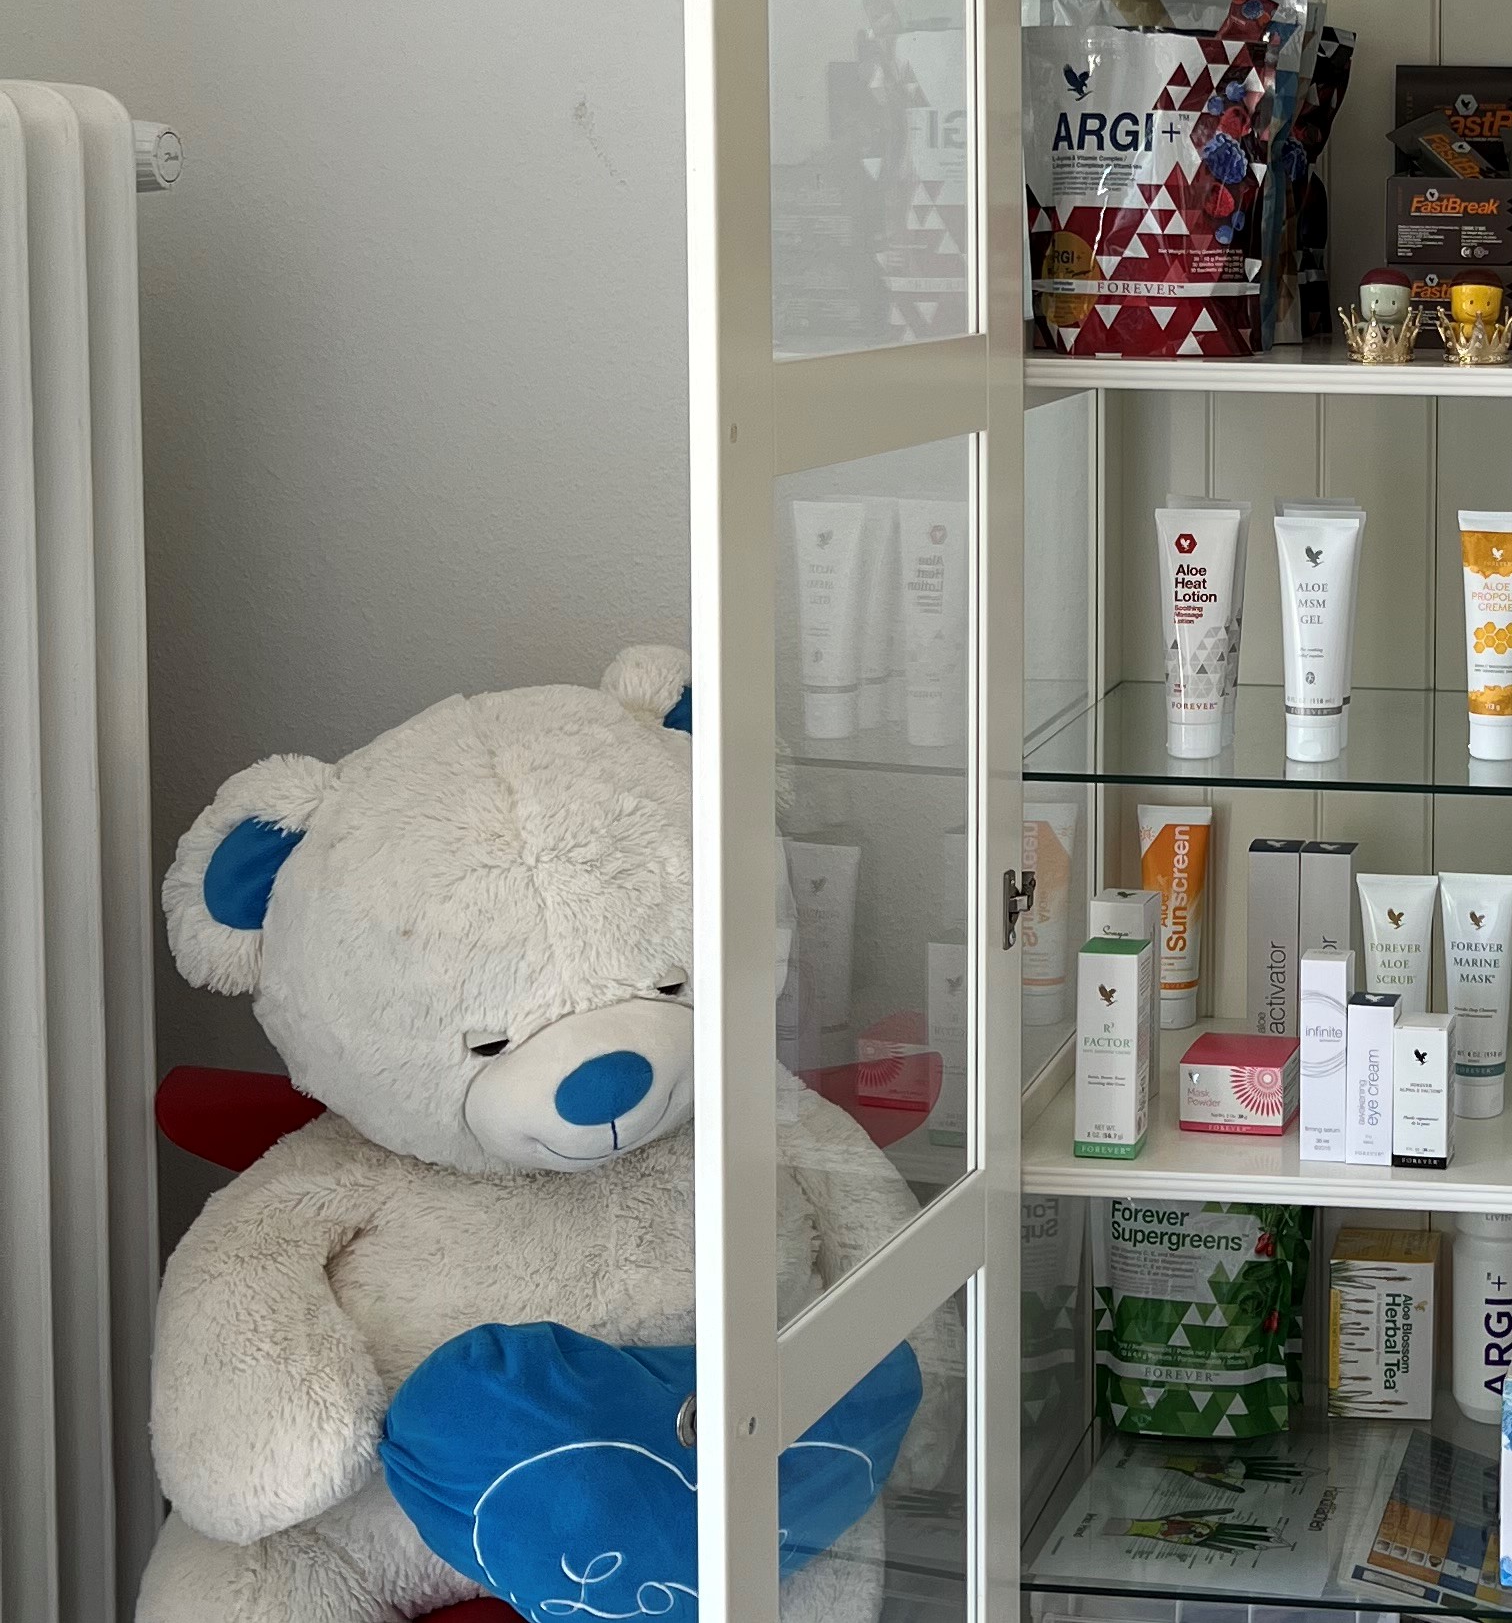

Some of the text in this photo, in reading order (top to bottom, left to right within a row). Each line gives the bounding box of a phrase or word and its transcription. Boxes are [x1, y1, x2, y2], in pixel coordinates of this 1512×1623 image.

[1410, 196, 1500, 215] FastBreak
[1097, 281, 1179, 296] FOREVER
[1175, 564, 1207, 576] Aloe
[1174, 578, 1208, 590] Heat
[1296, 582, 1329, 593] ALOE
[1483, 582, 1511, 592] ALOE
[1174, 591, 1218, 603] Lotion
[1174, 605, 1203, 613] Soothing
[1298, 598, 1327, 609] MSM
[1300, 614, 1324, 625] GEL
[1171, 701, 1216, 710] FOREVER
[1165, 825, 1191, 952] Sunscreen
[1369, 943, 1422, 953] FOREVER
[1450, 941, 1504, 952] FOREVER
[1379, 959, 1410, 969] ALOE
[1453, 957, 1501, 969] MARINE
[1375, 975, 1414, 985] SCRUB
[1459, 973, 1492, 984] MASK
[1269, 941, 1287, 1035] activator
[1257, 1012, 1267, 1034] aloe
[1305, 1025, 1343, 1039] infinite
[1083, 1037, 1131, 1048] FACTOR
[1187, 1088, 1210, 1097] Mask
[1368, 1049, 1382, 1126] eye cream
[1187, 1097, 1221, 1108] Powder
[1081, 1145, 1126, 1155] FOREVER
[1111, 1200, 1190, 1227] Forever
[1111, 1221, 1243, 1252] Supergreens
[1400, 1294, 1414, 1374] Aloe Blossom
[1383, 1293, 1402, 1391] Herbal Tea
[1144, 1368, 1214, 1382] FOREVER
